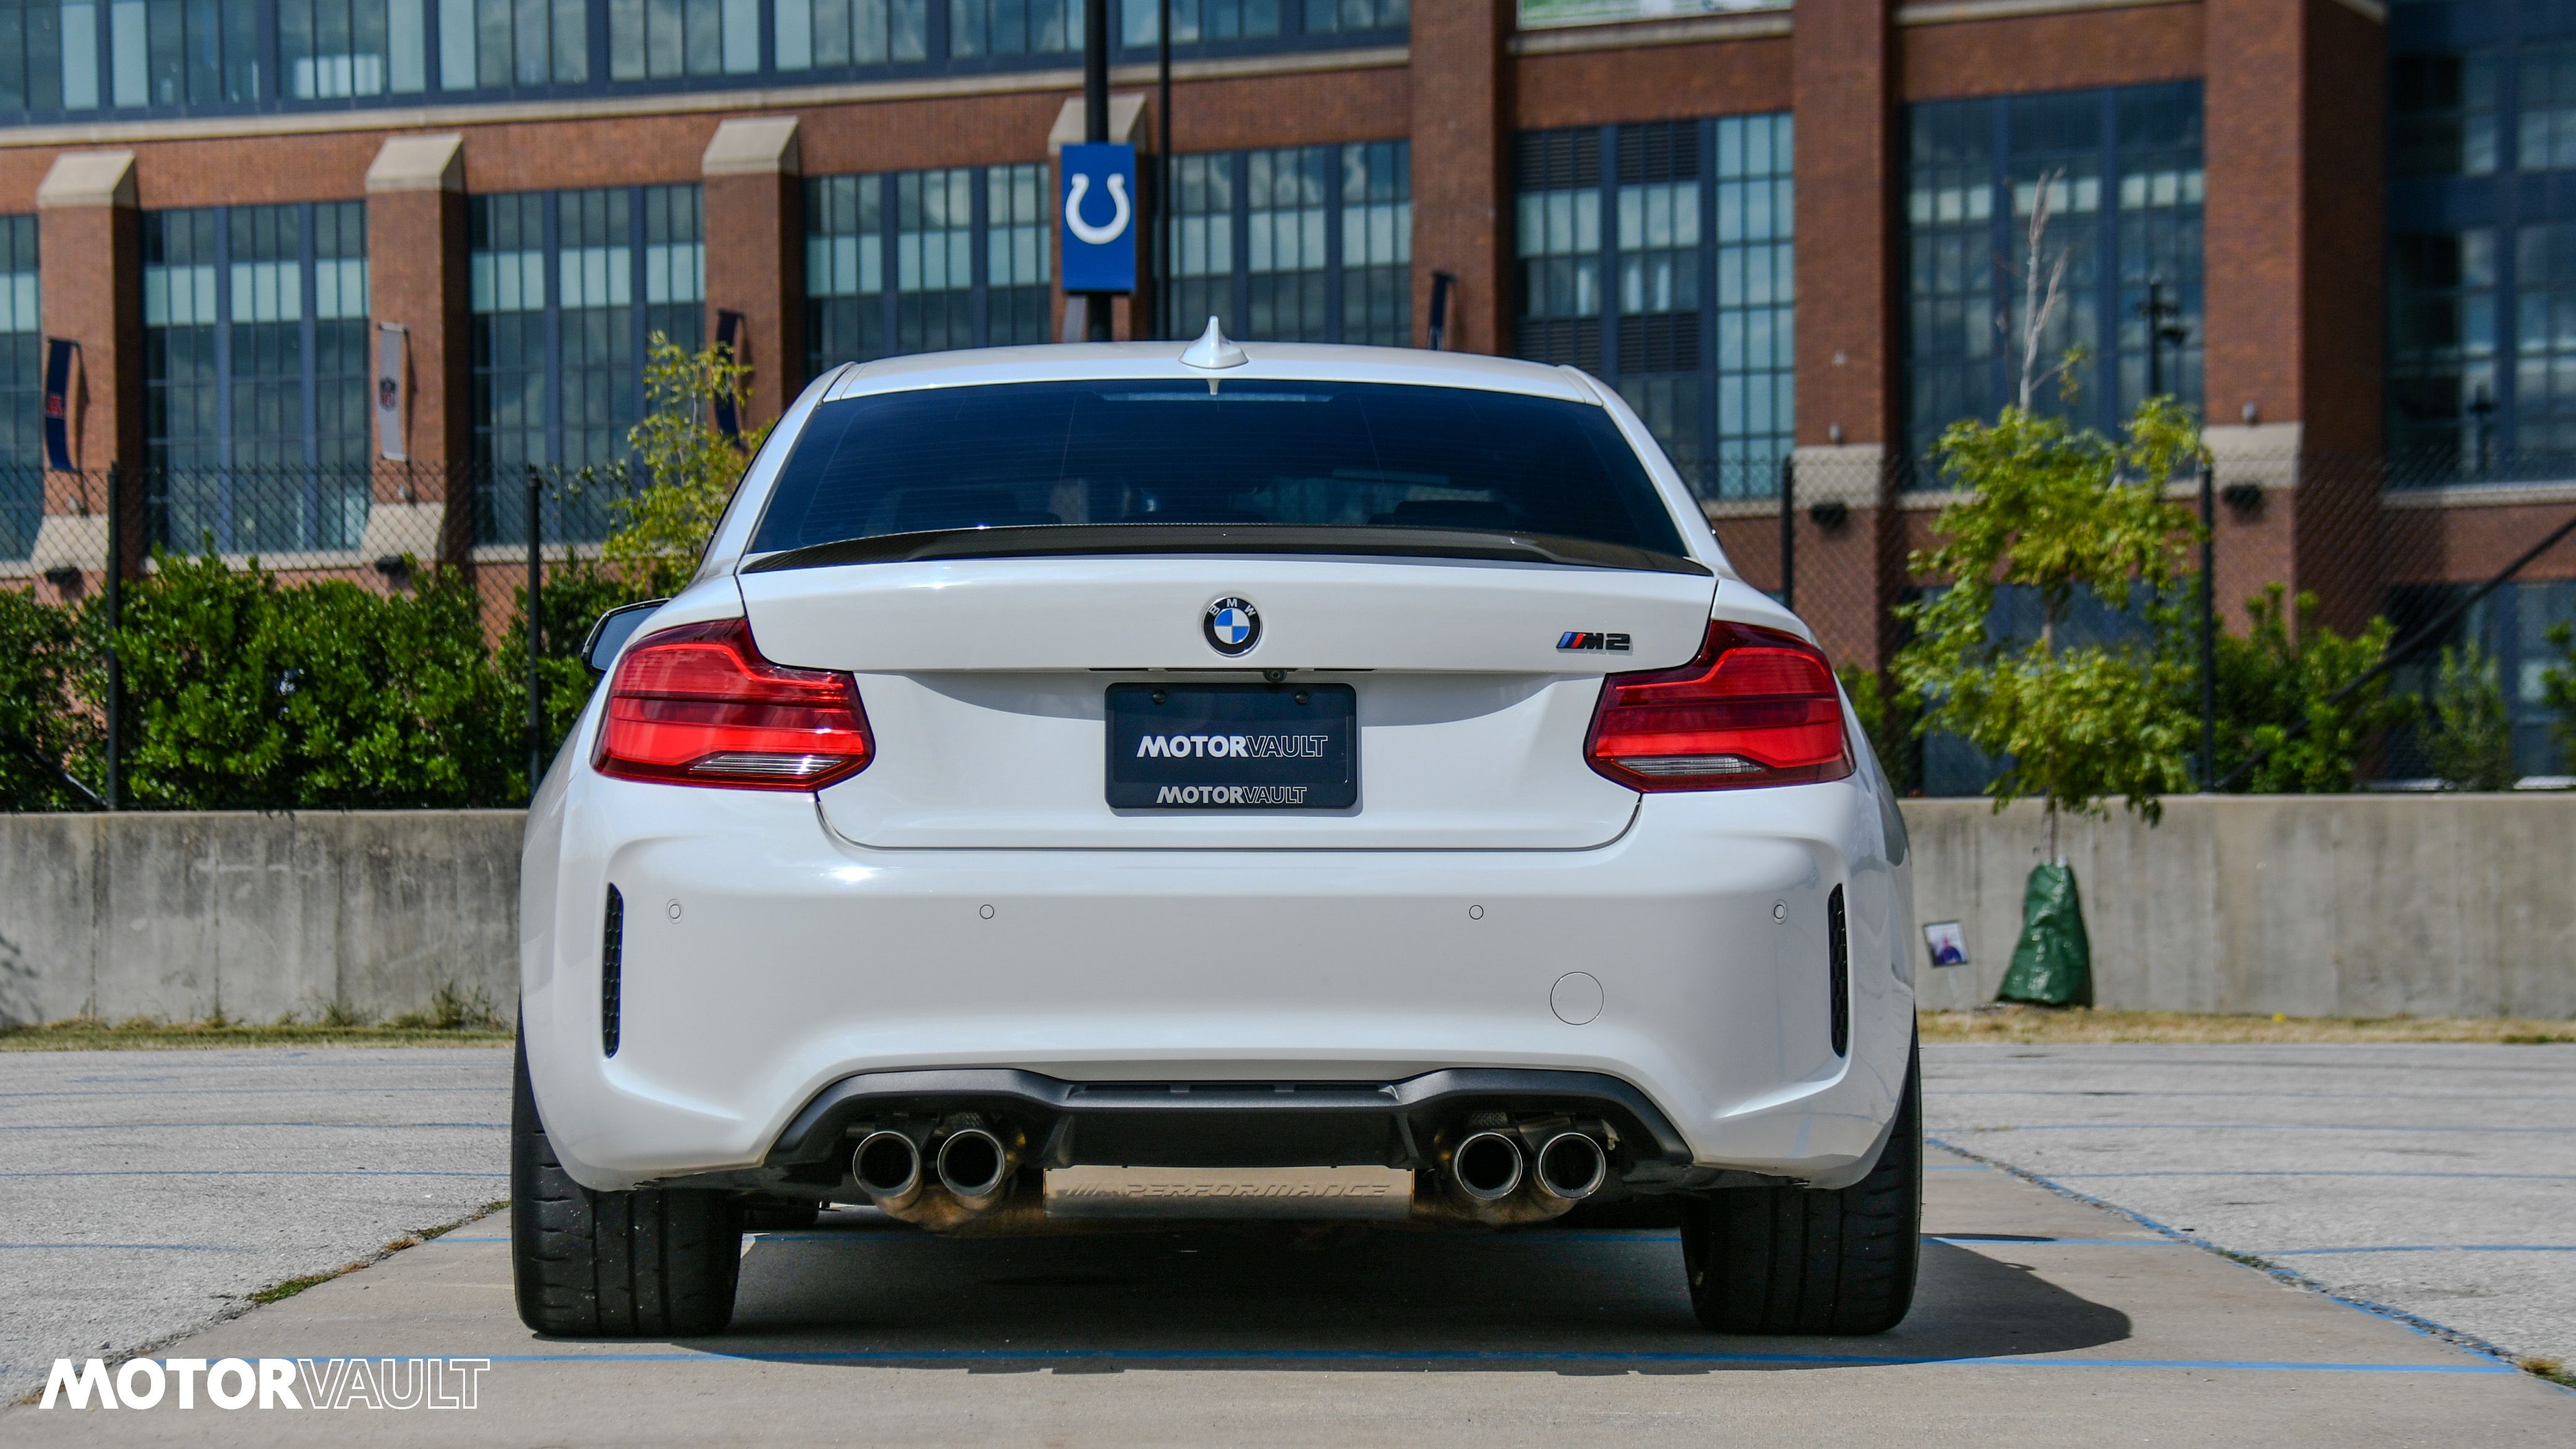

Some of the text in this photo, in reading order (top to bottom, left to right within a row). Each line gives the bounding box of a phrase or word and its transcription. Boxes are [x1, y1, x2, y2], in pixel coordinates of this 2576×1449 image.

[1209, 598, 1256, 617] BMW
[1136, 735, 1328, 758] MOTORVAULT
[1156, 786, 1307, 804] MOTORVAULT
[1128, 1184, 1390, 1197] PERFORMANCE
